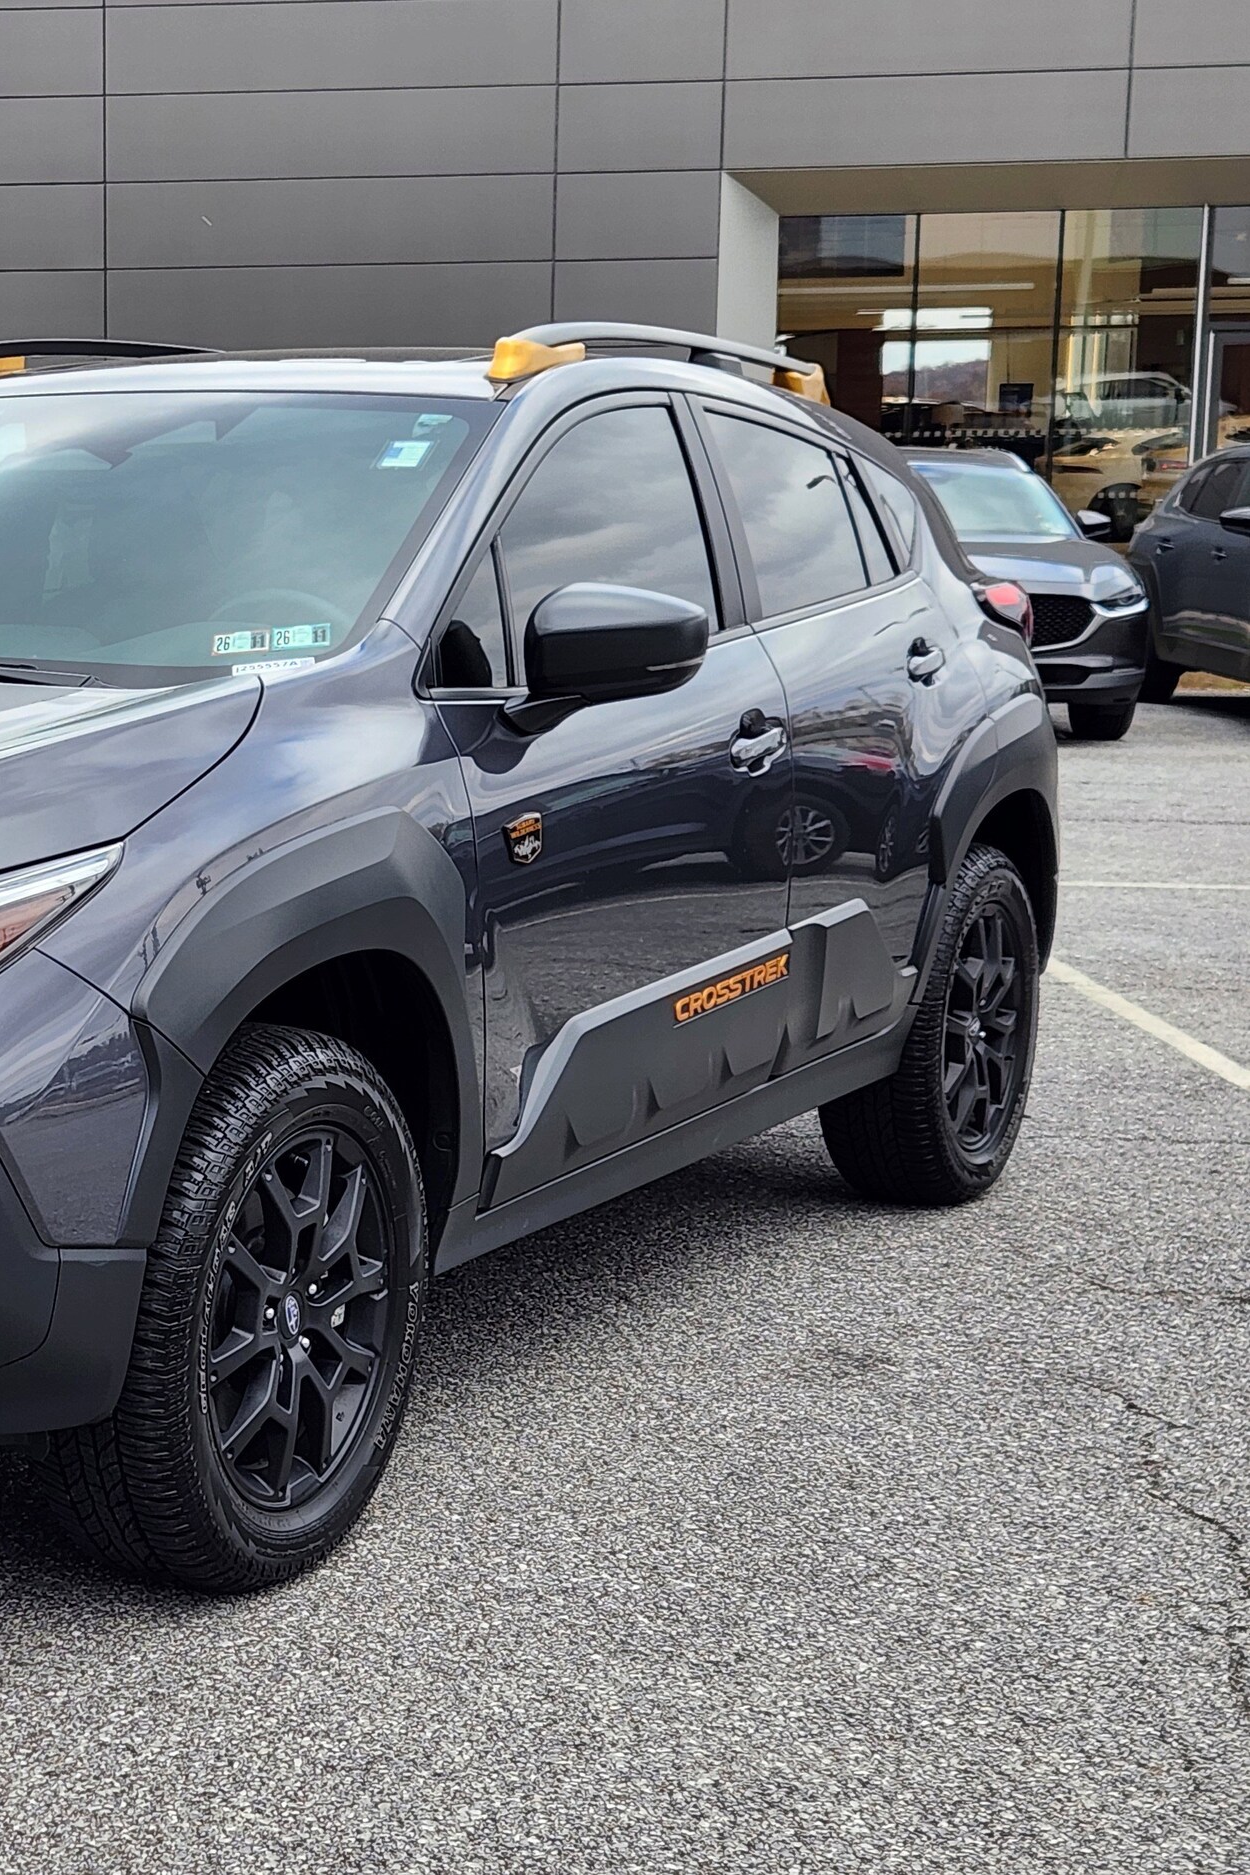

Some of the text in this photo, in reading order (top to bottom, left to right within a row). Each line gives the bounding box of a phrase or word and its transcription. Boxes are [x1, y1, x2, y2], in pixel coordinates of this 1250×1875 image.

[216, 636, 230, 651] 26
[251, 634, 266, 649] 11
[276, 630, 290, 646] 26
[312, 628, 327, 643] 11
[675, 953, 789, 1022] CROSSTREK
